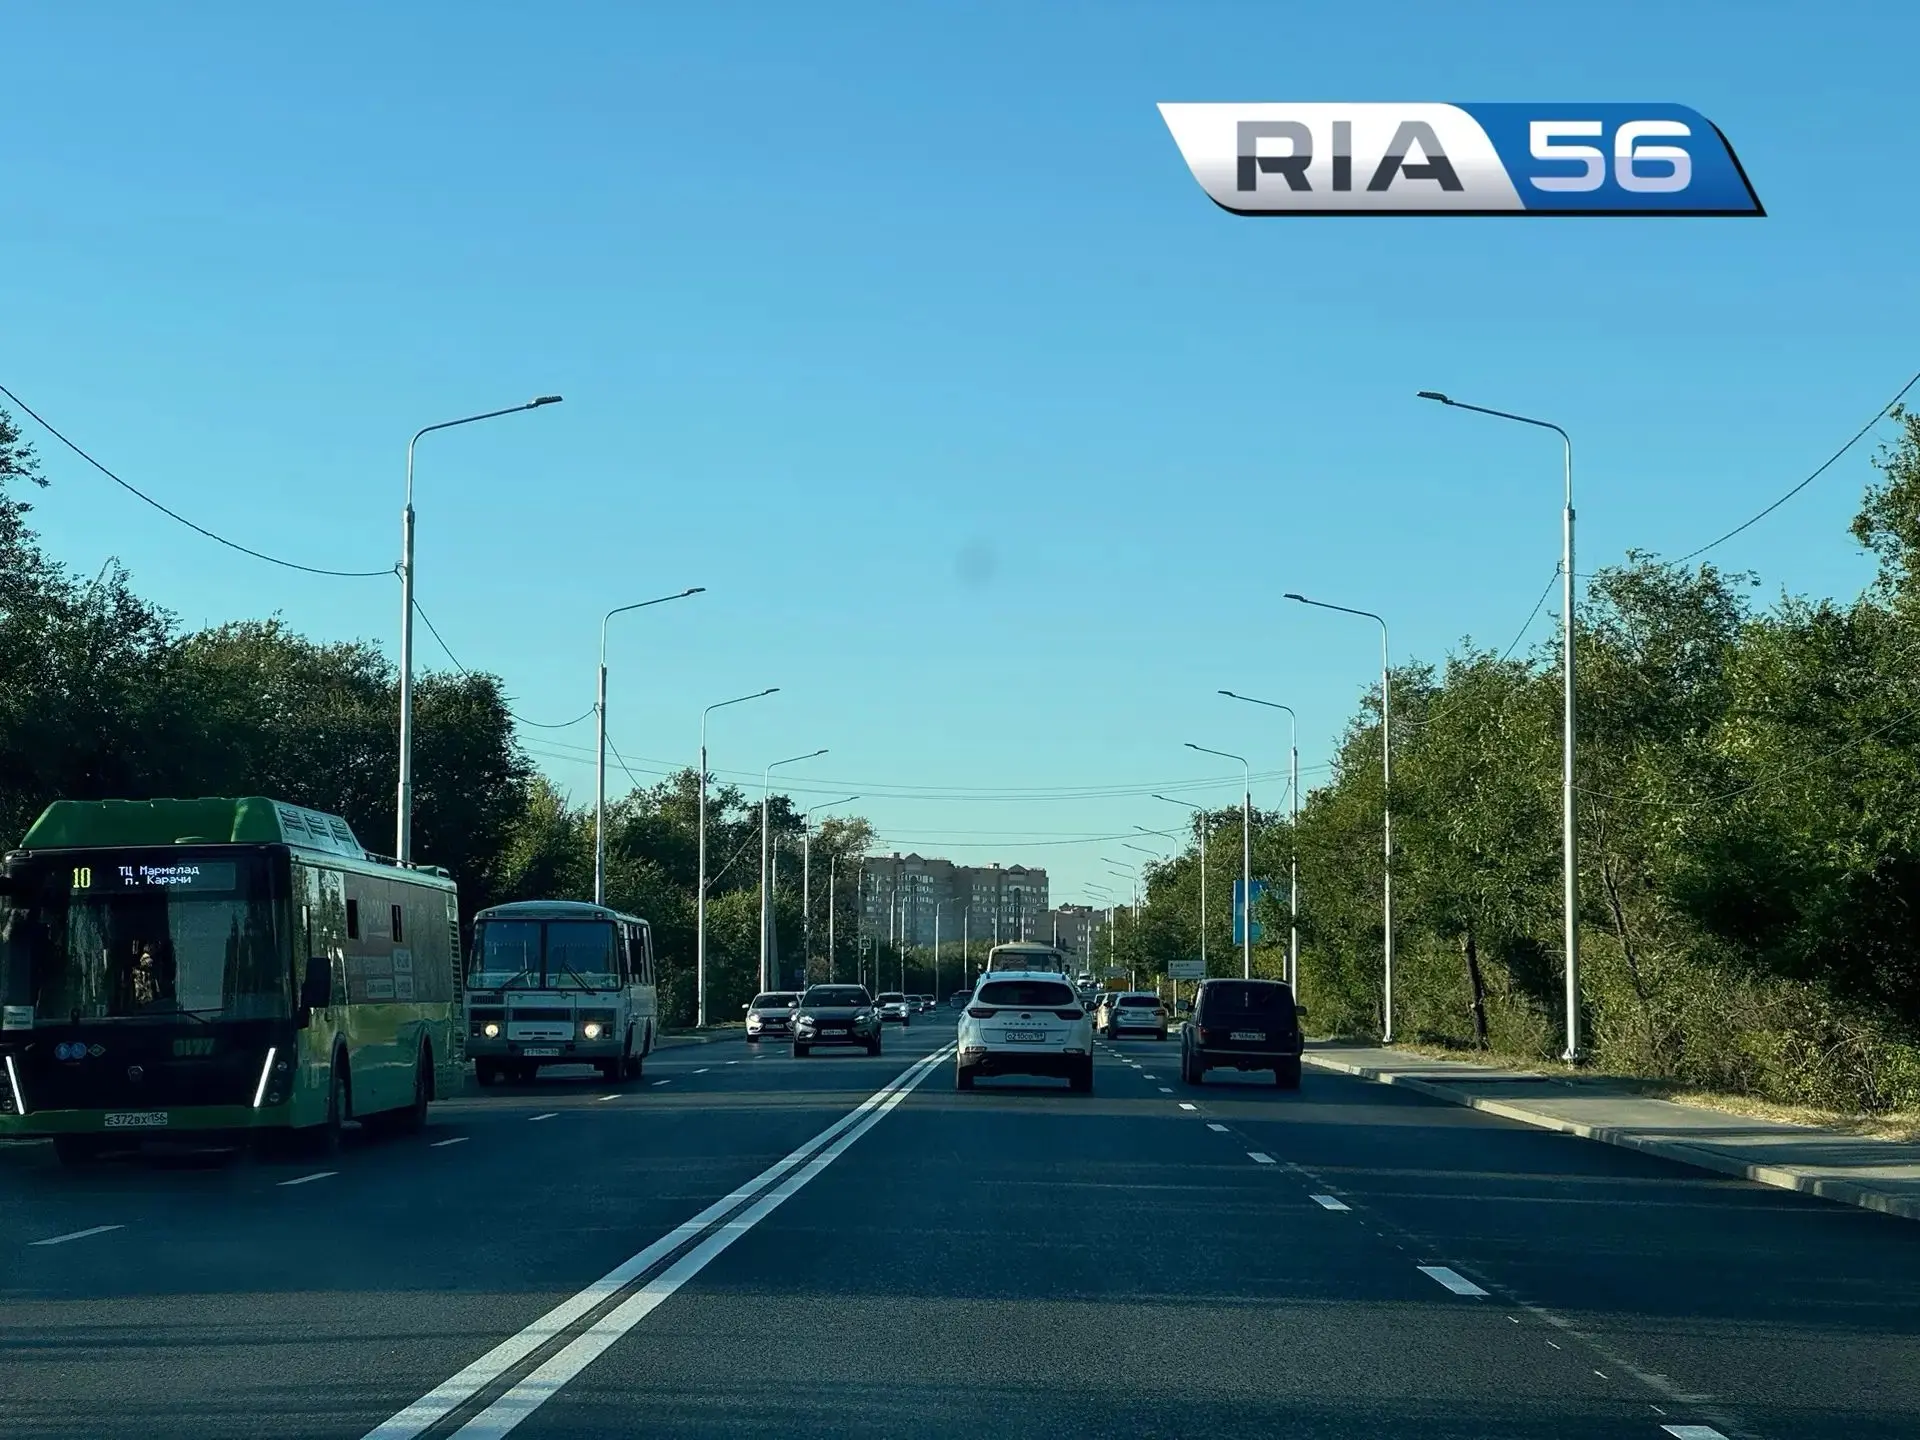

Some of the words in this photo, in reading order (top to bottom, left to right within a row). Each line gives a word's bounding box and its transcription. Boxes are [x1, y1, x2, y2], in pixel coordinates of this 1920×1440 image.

[118, 866, 133, 877] ТЦ
[139, 865, 200, 876] Мармелад
[73, 867, 91, 889] 10
[125, 877, 139, 885] п.
[146, 875, 192, 885] Карачи
